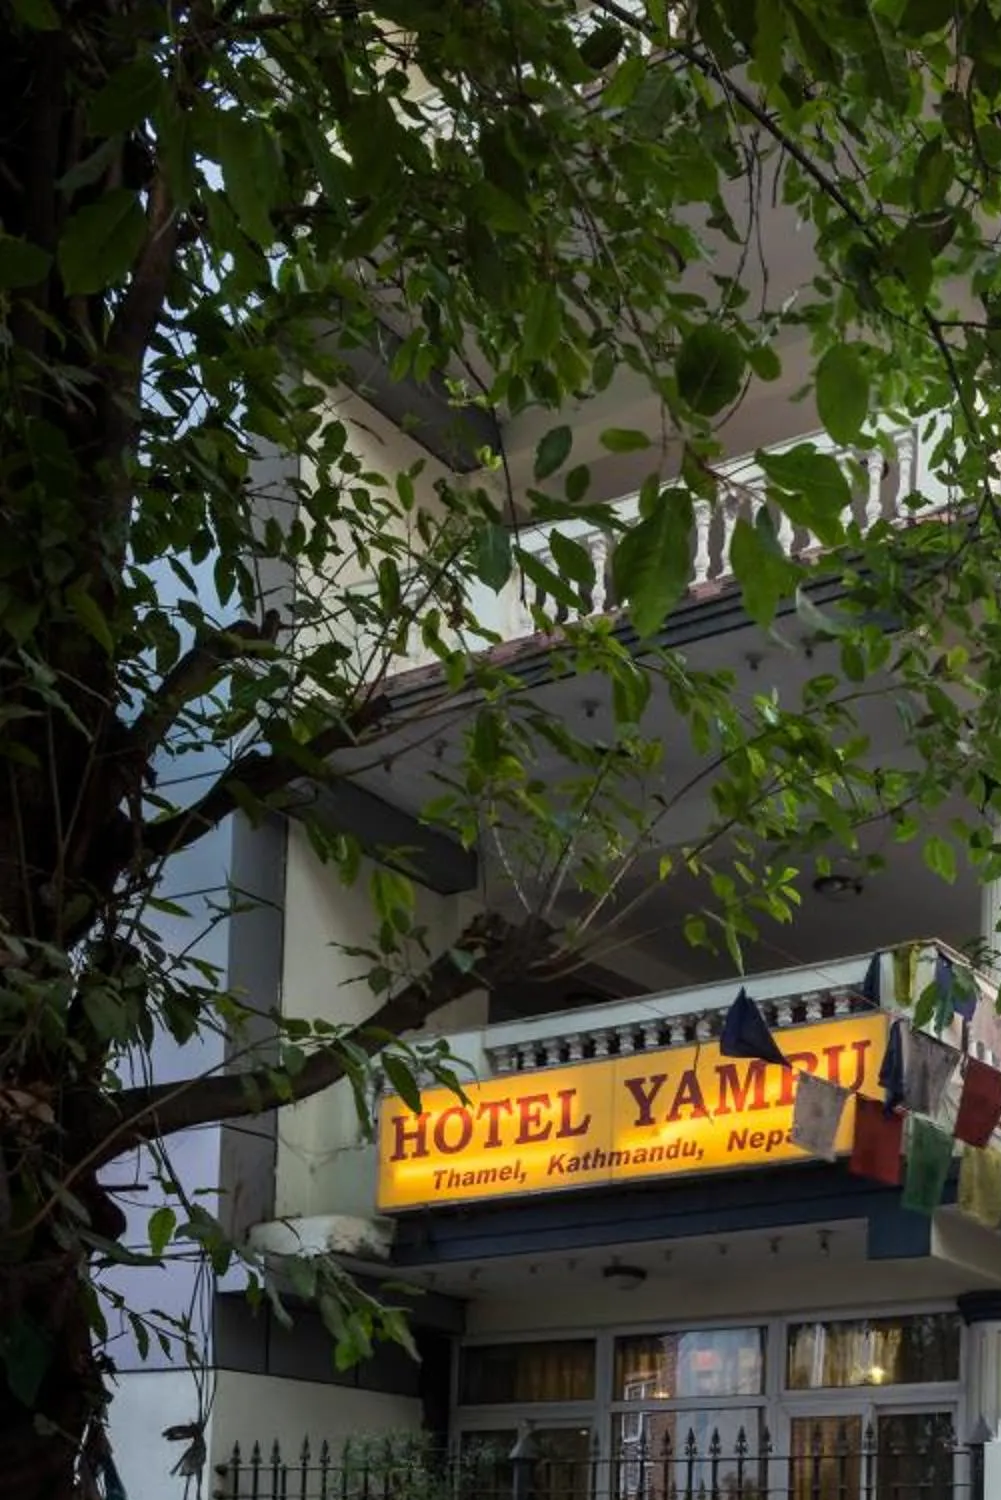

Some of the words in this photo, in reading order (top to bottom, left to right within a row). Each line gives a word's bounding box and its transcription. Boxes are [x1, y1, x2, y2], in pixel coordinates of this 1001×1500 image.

[389, 1088, 592, 1163] HOTEL
[433, 1160, 528, 1190] Thamel,
[546, 1137, 704, 1177] Kathmandu,
